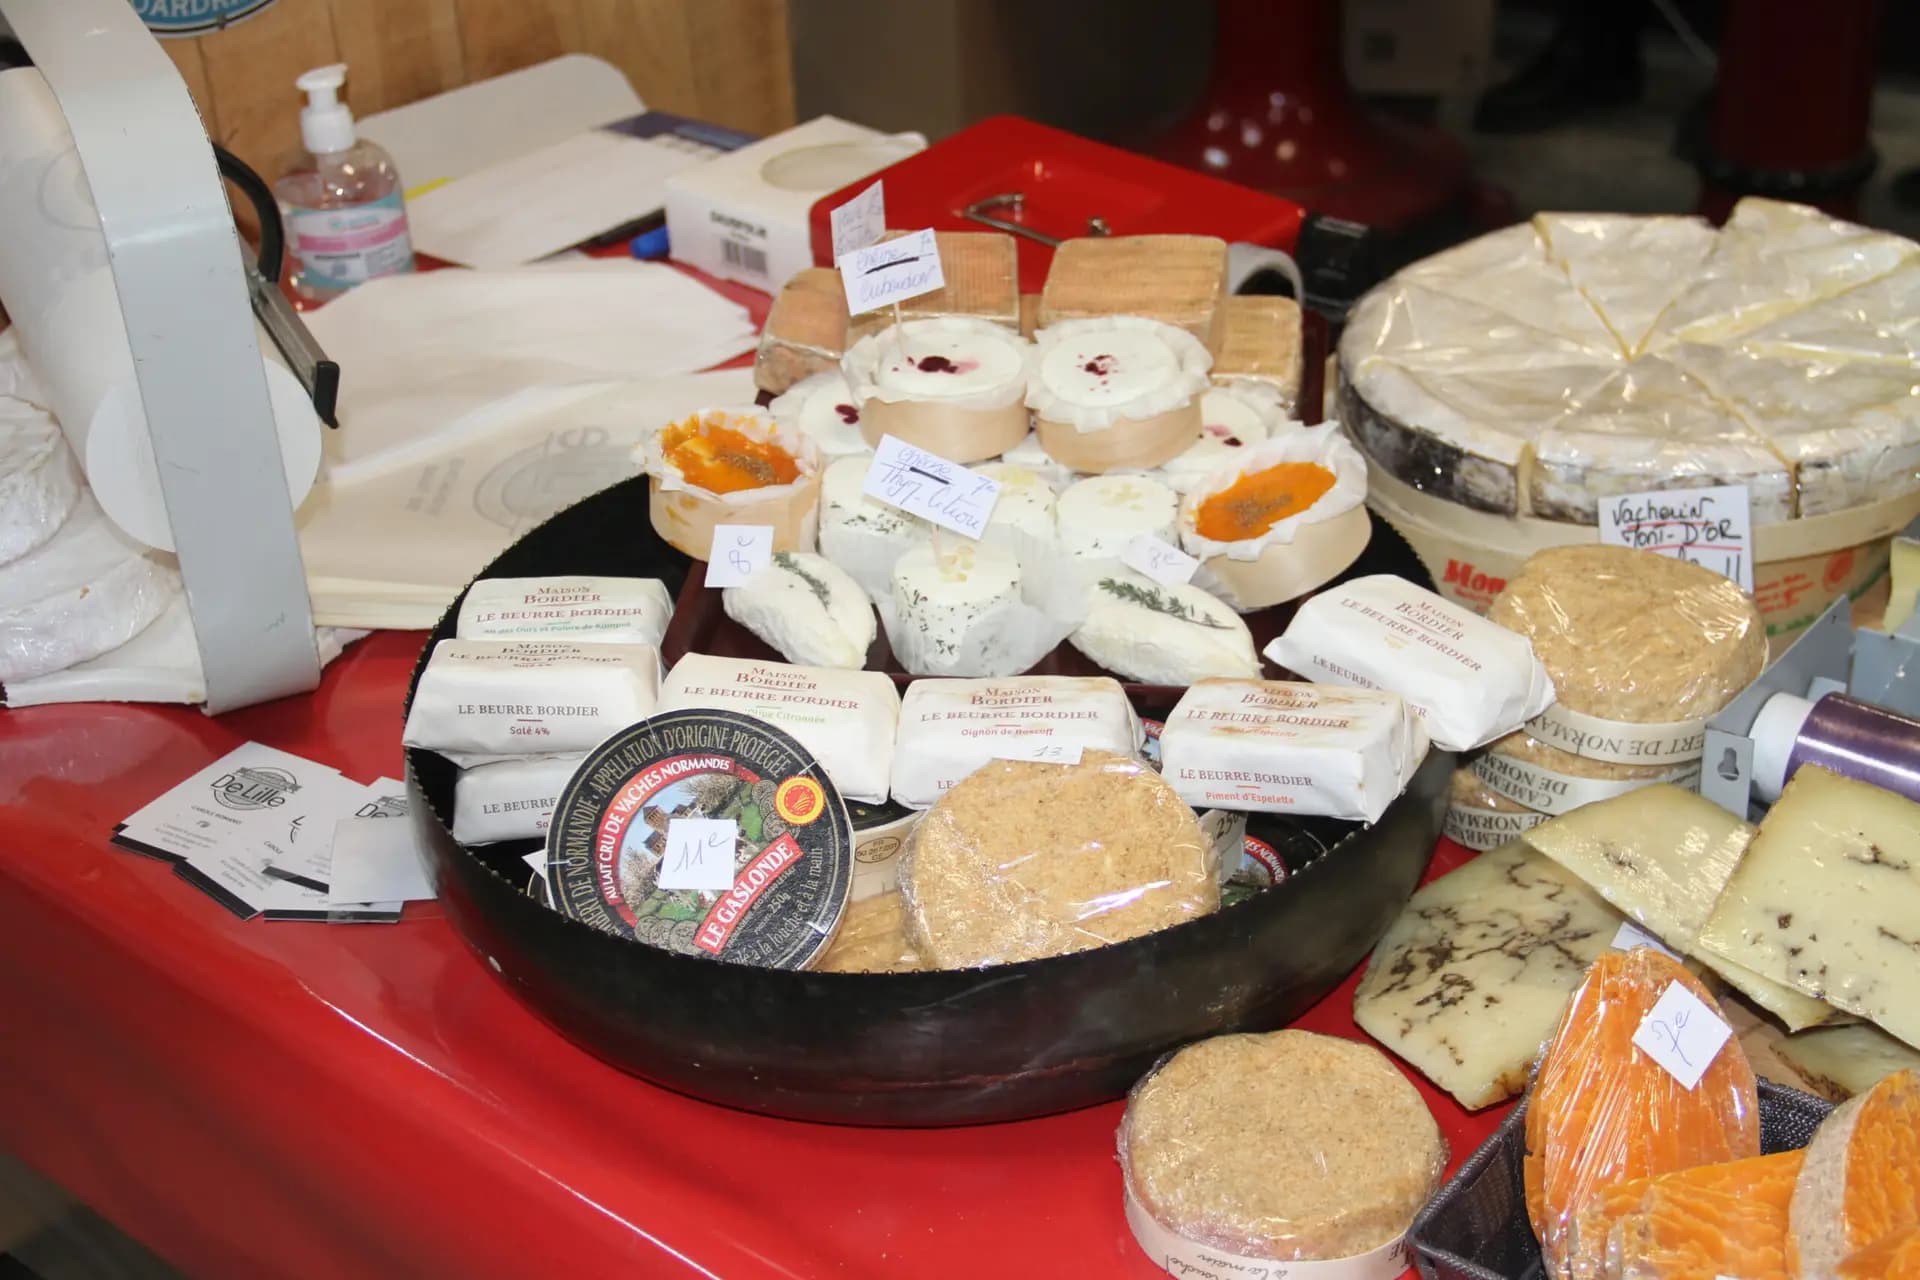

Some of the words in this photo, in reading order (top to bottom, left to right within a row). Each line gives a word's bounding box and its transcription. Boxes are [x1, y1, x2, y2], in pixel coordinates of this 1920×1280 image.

[524, 594, 602, 604] BORDIER
[476, 613, 497, 623] LE
[501, 609, 566, 620] BEURRE
[570, 607, 643, 618] BORDIER
[1395, 601, 1464, 641] BORDIER
[1341, 598, 1361, 610] LE
[1360, 606, 1418, 637] BEURRE
[1417, 633, 1483, 672] BORDIER
[736, 672, 817, 690] BORDIER
[751, 666, 808, 680] MAISON
[1312, 655, 1327, 669] LE
[1329, 662, 1373, 690] BEURRE
[684, 686, 705, 695] LE
[710, 688, 777, 702] BEURRE
[781, 695, 860, 710] BORDIER
[971, 695, 1053, 705] BORDIER
[985, 687, 1041, 697] MAISON
[1241, 694, 1318, 709] BORDIER
[458, 704, 476, 715] LE
[479, 704, 533, 716] BEURRE
[538, 705, 599, 717] BORDIER
[921, 713, 941, 722] LE
[946, 711, 1018, 720] BEURRE
[1020, 711, 1099, 720] BORDIER
[1186, 709, 1208, 720] LE
[1210, 711, 1273, 724] BEURRE
[1275, 714, 1350, 729] BORDIER
[510, 725, 531, 735] Salé
[1627, 739, 1660, 757] DE
[660, 757, 731, 779] NORMANDES
[1180, 768, 1195, 779] LE
[1199, 769, 1252, 782] BEURRE
[1254, 773, 1313, 787] BORDIER
[211, 774, 243, 793] De
[241, 783, 285, 807] Lille
[615, 771, 662, 815] VACHES
[1538, 776, 1569, 796] DE
[566, 796, 601, 880] NORMANDIE
[593, 734, 663, 798] APPELLATION
[663, 725, 731, 752] D'ORIGINE
[1206, 791, 1240, 802] Piment
[483, 803, 501, 815] LE
[605, 811, 625, 835] DE
[600, 835, 616, 862] CRU
[600, 863, 614, 886] LAIT
[702, 922, 727, 948] LE
[716, 842, 794, 923] GASLONDE
[767, 911, 804, 946] louche
[807, 847, 824, 879] main
